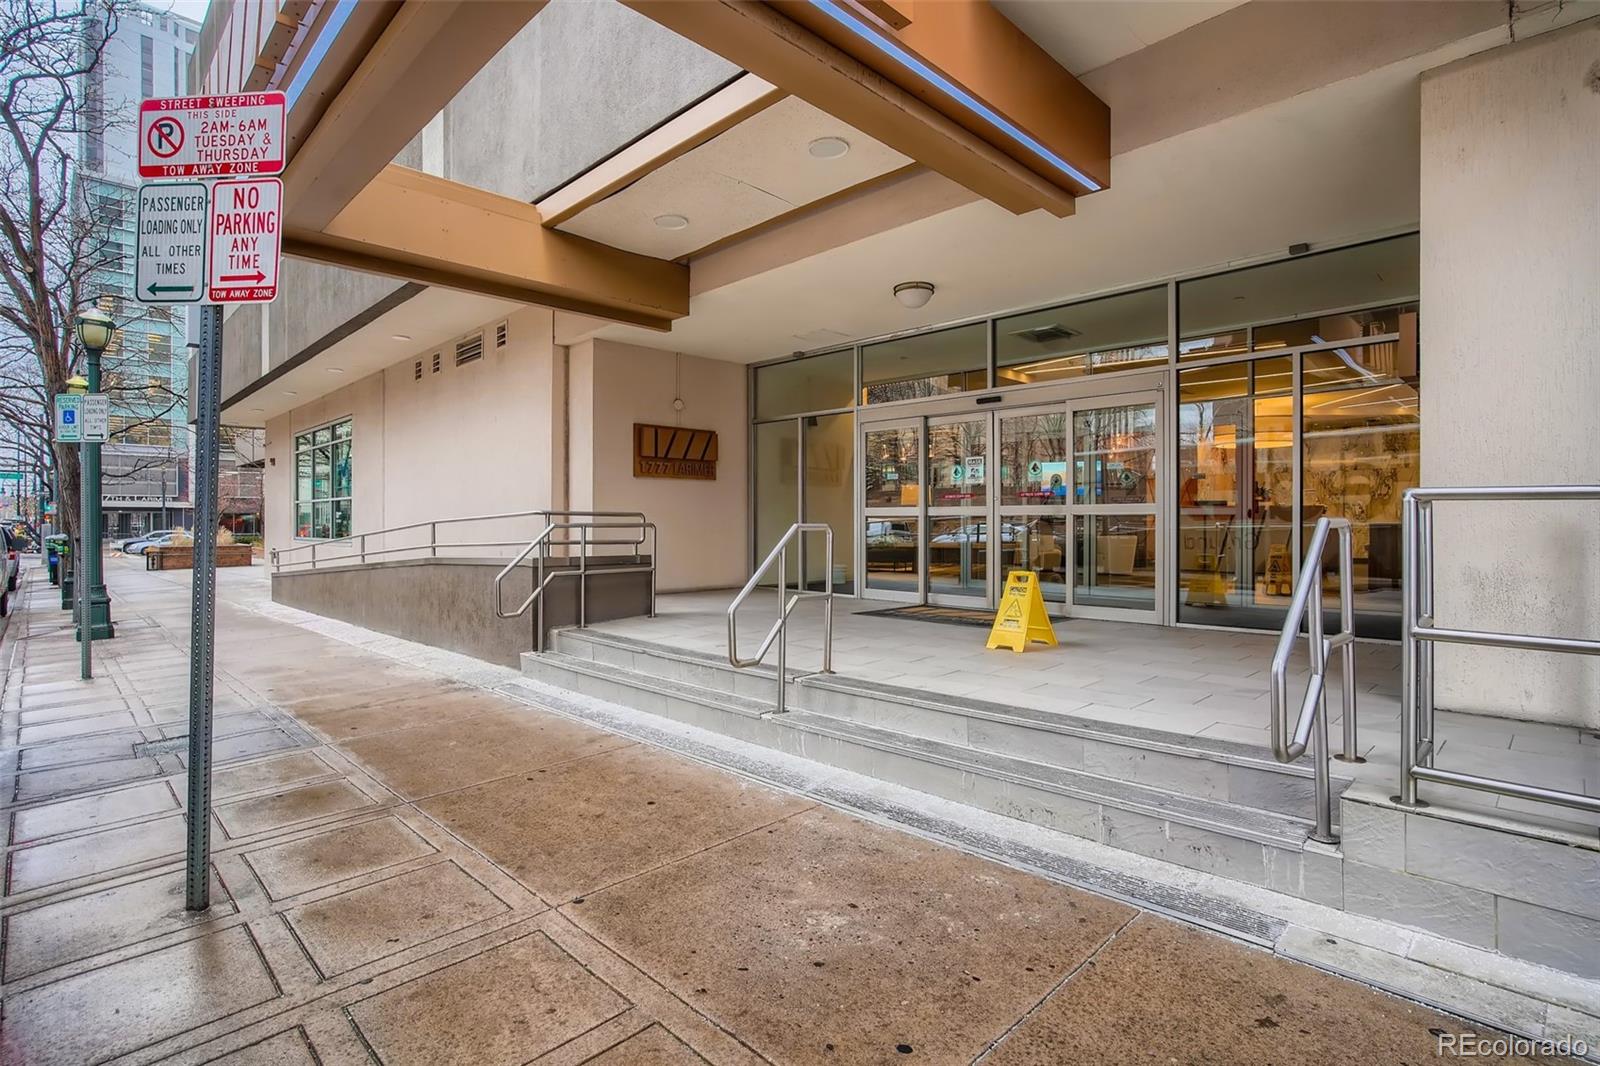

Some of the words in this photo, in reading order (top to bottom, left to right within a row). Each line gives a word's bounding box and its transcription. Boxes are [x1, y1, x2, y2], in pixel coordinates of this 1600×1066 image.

[160, 99, 201, 110] STREET
[208, 95, 265, 108] SWEEPING
[187, 111, 209, 119] THIS
[215, 109, 237, 118] SIDE
[194, 133, 255, 148] TUESDAY
[262, 132, 272, 145] &
[197, 147, 269, 162] THURSDAY
[163, 165, 185, 176] TOW
[192, 164, 222, 175] AWAY
[229, 162, 259, 173] ZONE
[142, 196, 204, 212] PASSENGER
[233, 186, 259, 209] NO
[141, 220, 178, 235] LOADING
[180, 219, 203, 234] ONLY
[216, 211, 275, 235] PARKING
[141, 246, 160, 257] ALL
[169, 245, 200, 256] OTHER
[231, 237, 259, 252] ANY
[156, 263, 186, 275] TIMES
[228, 254, 260, 270] TIME
[211, 290, 227, 298] TOW
[229, 289, 250, 298] AWAY
[253, 289, 273, 297] ZONE
[639, 461, 672, 475] 1777
